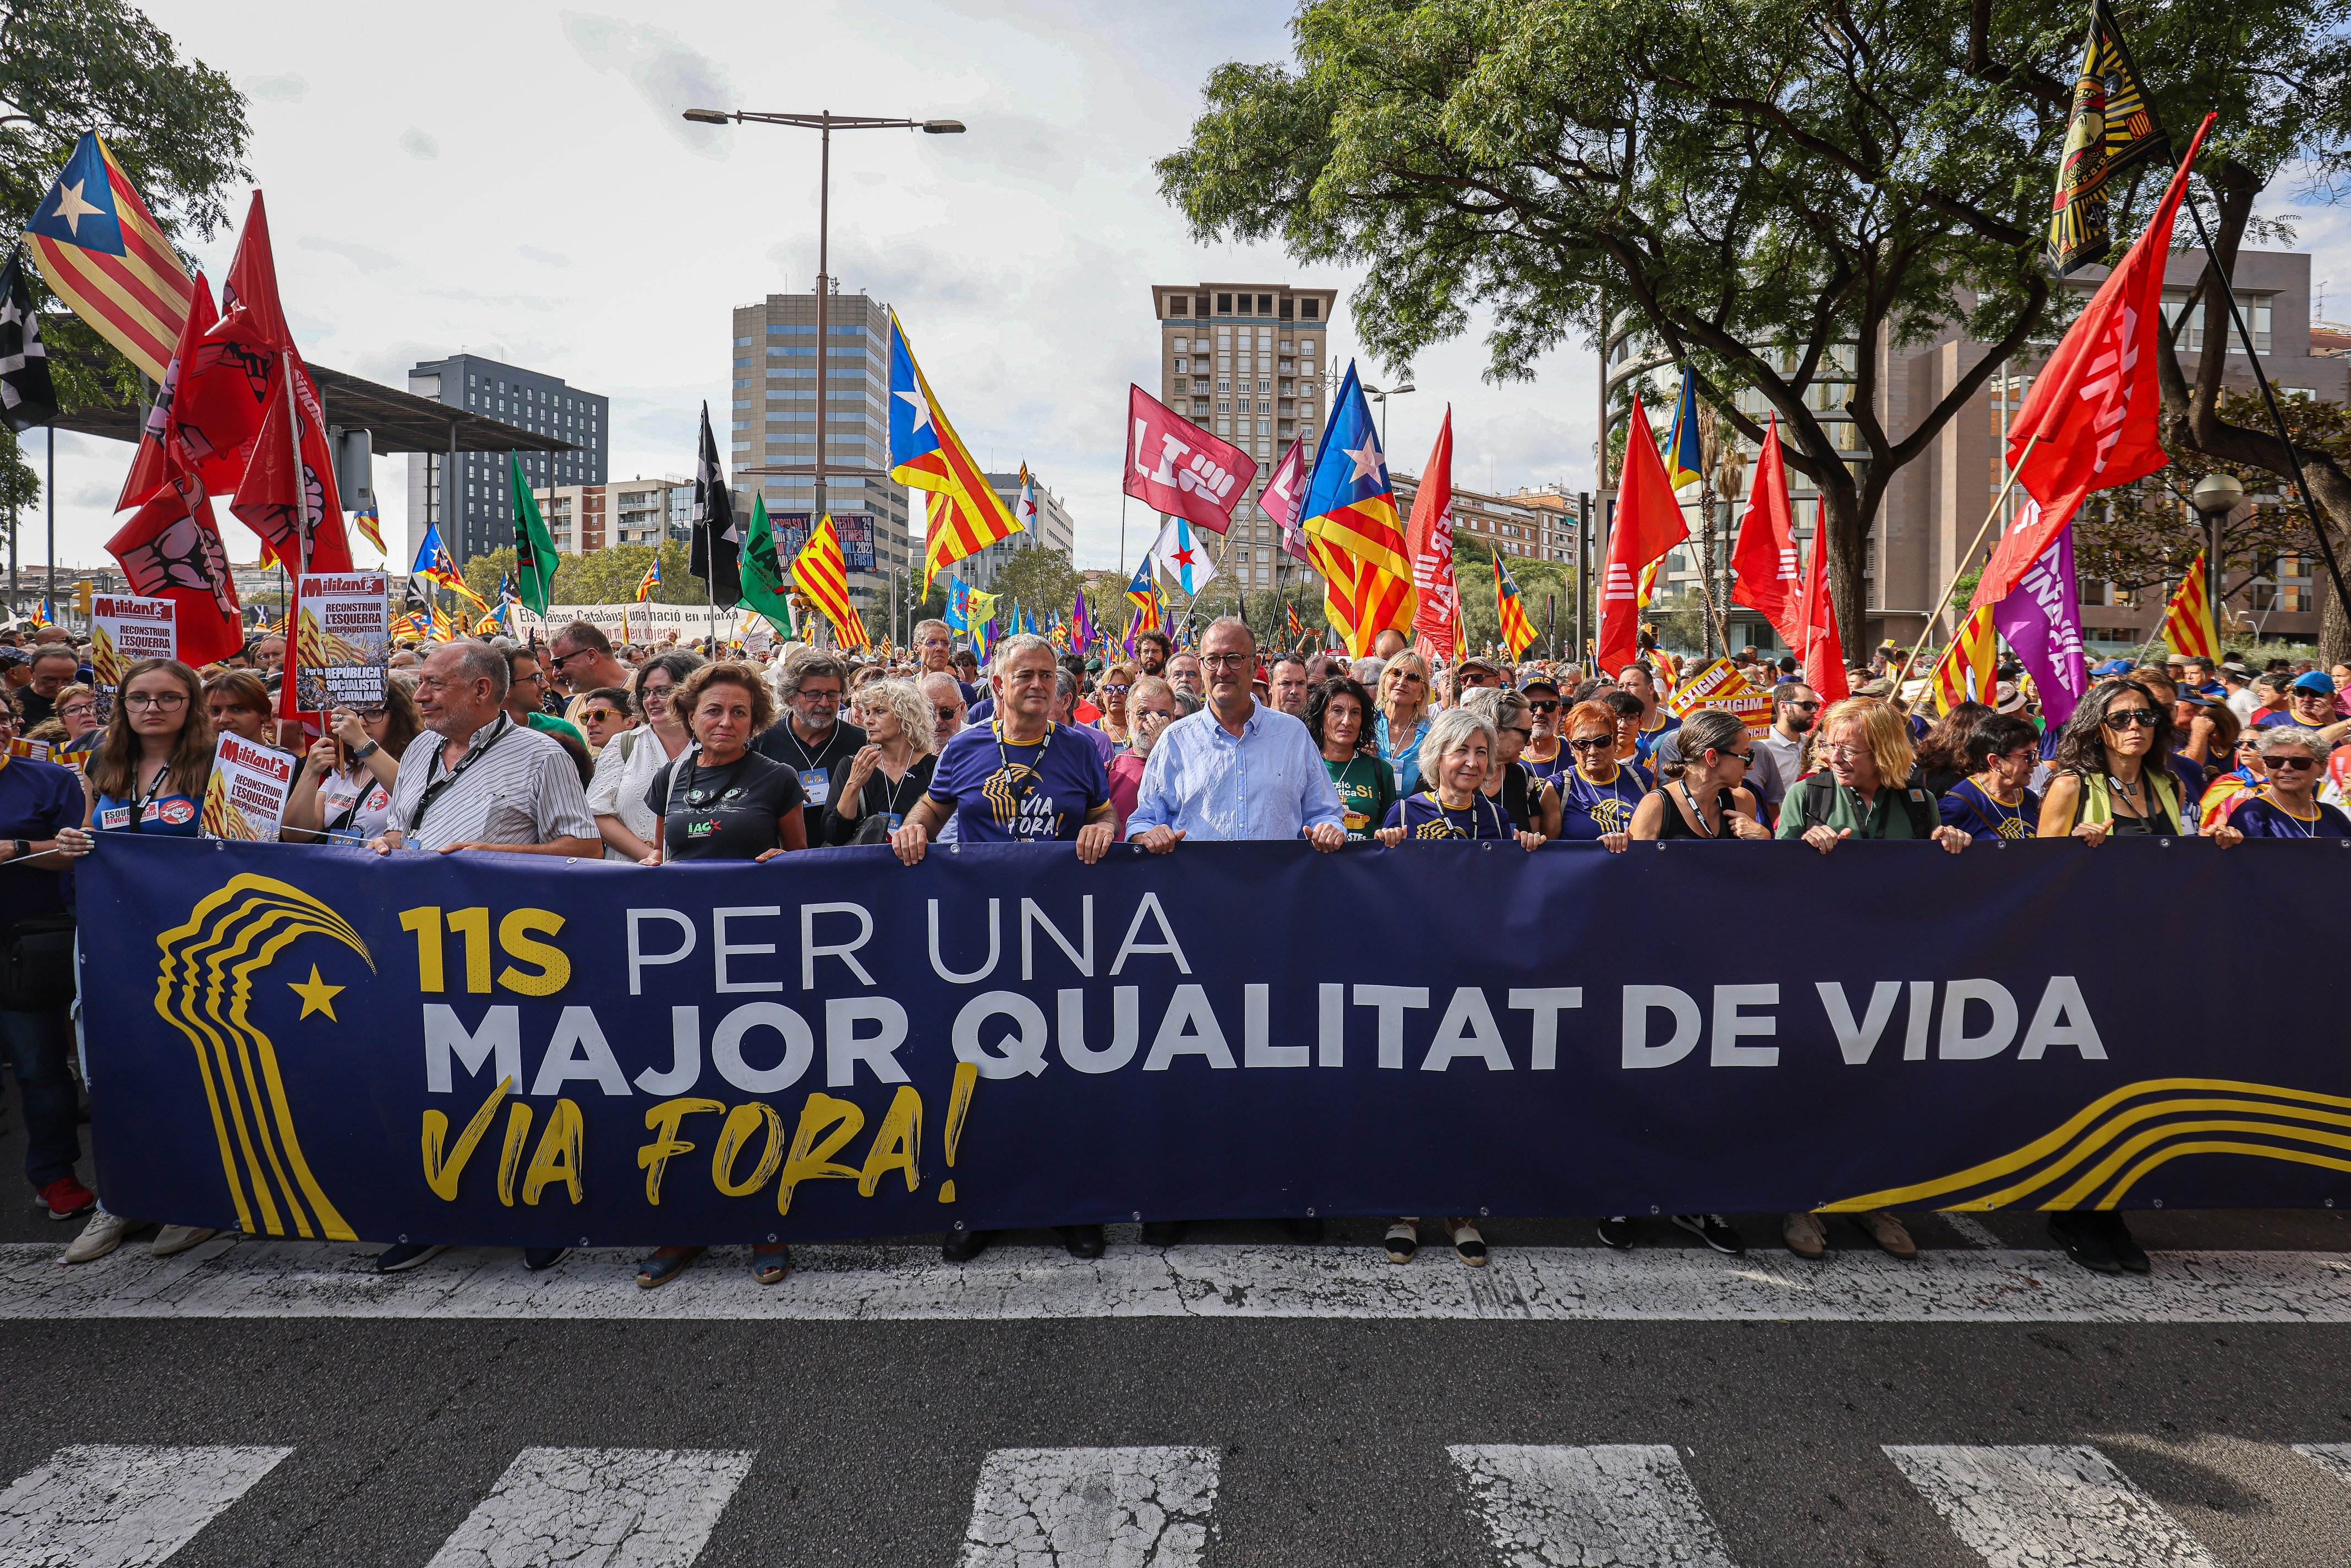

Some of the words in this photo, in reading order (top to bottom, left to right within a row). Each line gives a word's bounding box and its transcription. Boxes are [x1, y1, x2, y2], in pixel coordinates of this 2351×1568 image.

[835, 517, 855, 529] FESTA
[862, 517, 871, 529] 24
[864, 529, 872, 542] 09
[856, 542, 873, 554] 2023
[846, 554, 852, 566] LA
[854, 554, 874, 566] FUSTA
[326, 603, 381, 613] RECONSTRUIR
[325, 613, 381, 624] L'ESQUERRA
[519, 609, 536, 622] Els
[630, 610, 646, 621] una
[650, 609, 680, 621] nació
[685, 613, 699, 621] en
[120, 625, 170, 637] RECONSTRUIR
[615, 626, 642, 639] mteix
[119, 636, 171, 648] L'ESQUERRA
[119, 648, 171, 658] INDEPENDENTISTA
[305, 668, 316, 676] Per
[325, 665, 381, 679] REPÚBLICA
[103, 685, 114, 693] Per
[326, 679, 382, 691] SOCIALISTA
[1677, 666, 1729, 711] EXIGIM
[337, 691, 382, 702] CATALANA
[1705, 697, 1763, 712] EXIGIM
[235, 773, 282, 799] RECONSTRUIR
[232, 784, 280, 811] L'ESQUERRA
[230, 797, 277, 821] INDEPENDENTISTA
[1020, 793, 1053, 816] VIA
[105, 808, 130, 819] ESQUE
[398, 906, 570, 996] 11S
[627, 902, 877, 995] PER
[928, 893, 1192, 984] UNA
[423, 997, 911, 1095] MAJOR
[952, 984, 1583, 1079] QUALITAT
[1622, 984, 1779, 1069] DE
[1815, 976, 2108, 1064] VIDA
[422, 1076, 583, 1205] VIA
